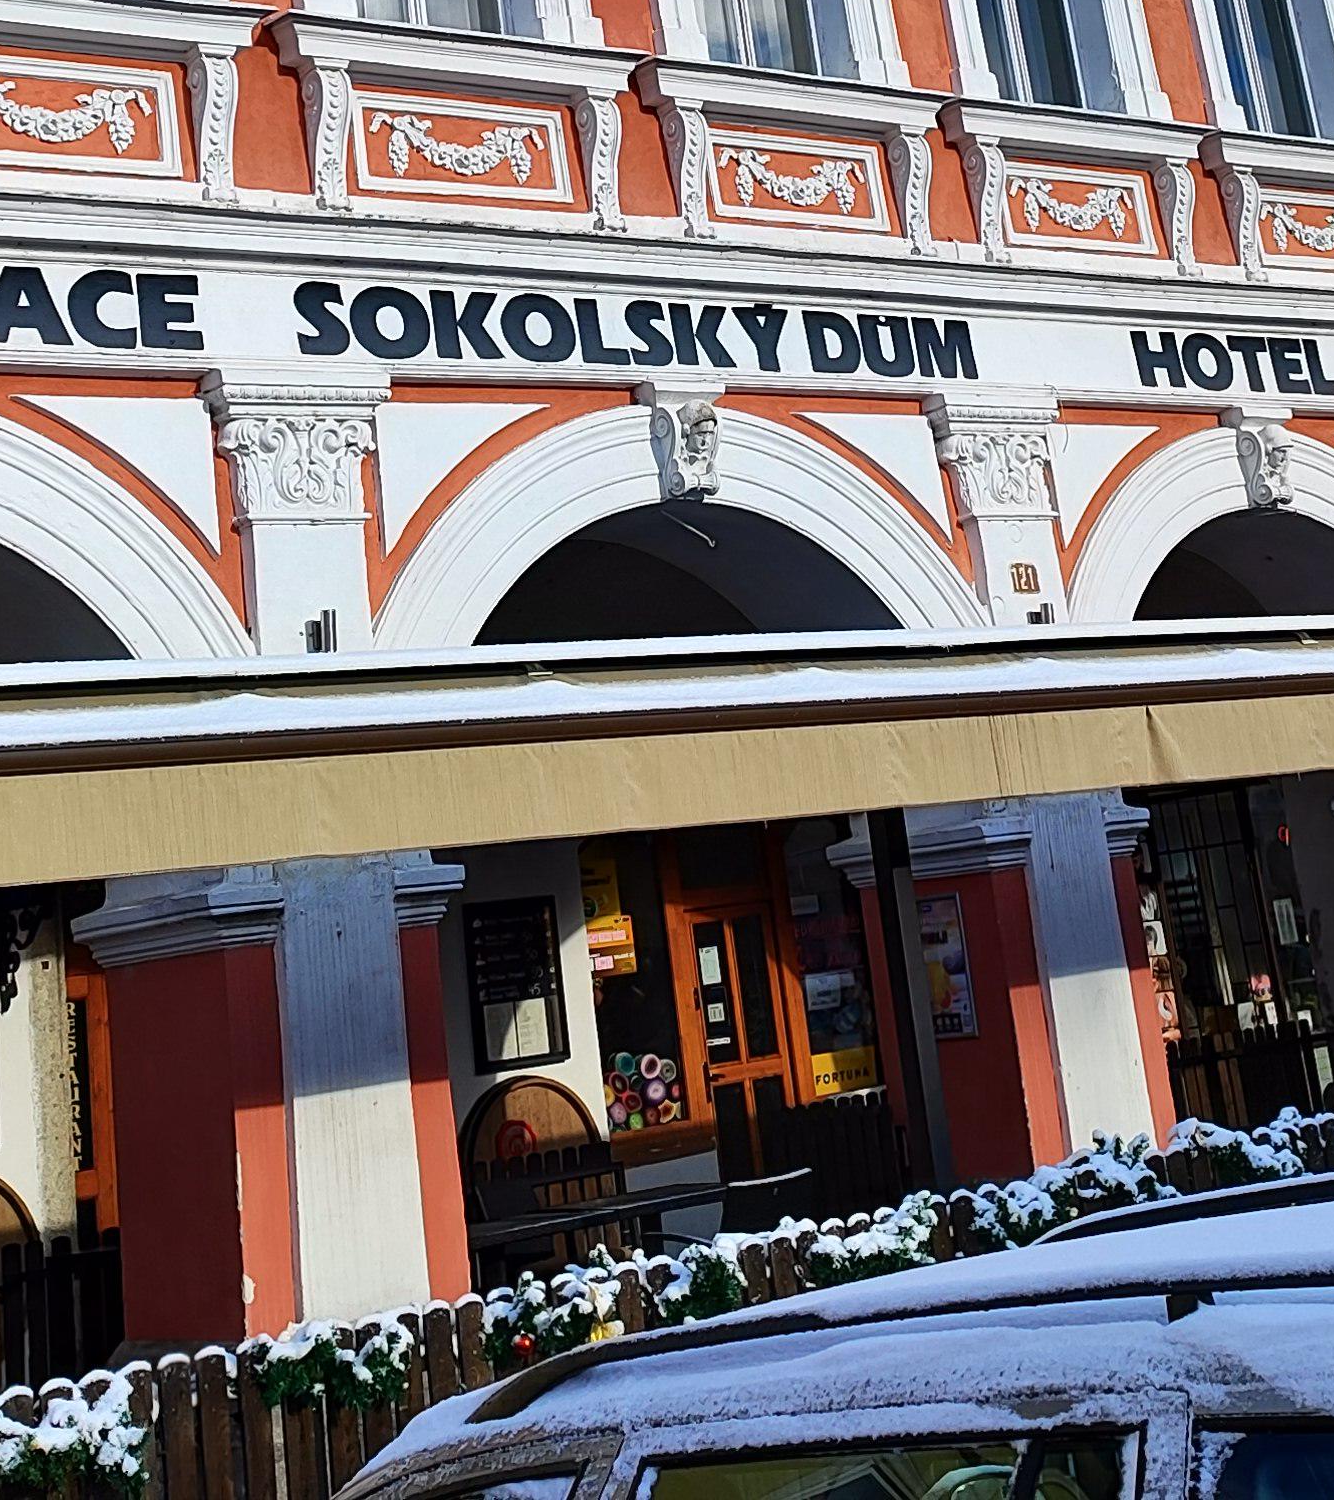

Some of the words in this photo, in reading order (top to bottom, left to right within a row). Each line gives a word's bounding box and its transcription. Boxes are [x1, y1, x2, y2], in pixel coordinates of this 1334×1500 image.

[294, 281, 785, 373] SOKOLSKÝ
[802, 310, 978, 380] DŮM
[1011, 565, 1035, 590] 121
[815, 1064, 870, 1086] FORTUNA
